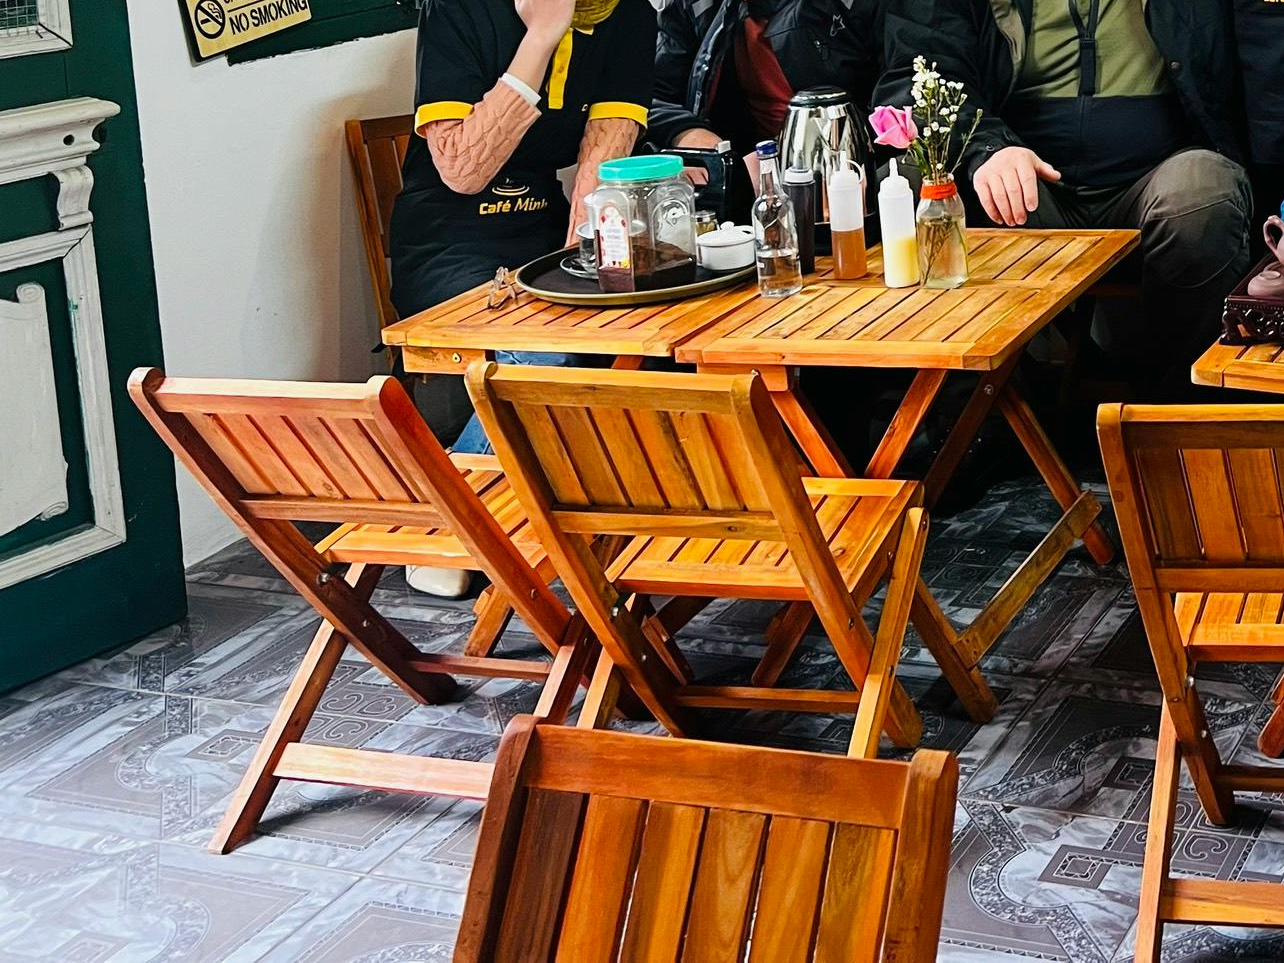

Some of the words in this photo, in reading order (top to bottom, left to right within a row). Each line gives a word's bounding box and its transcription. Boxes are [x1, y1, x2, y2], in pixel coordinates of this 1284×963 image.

[229, 13, 250, 35] NO
[479, 200, 511, 215] Café
[514, 197, 548, 212] Minh
